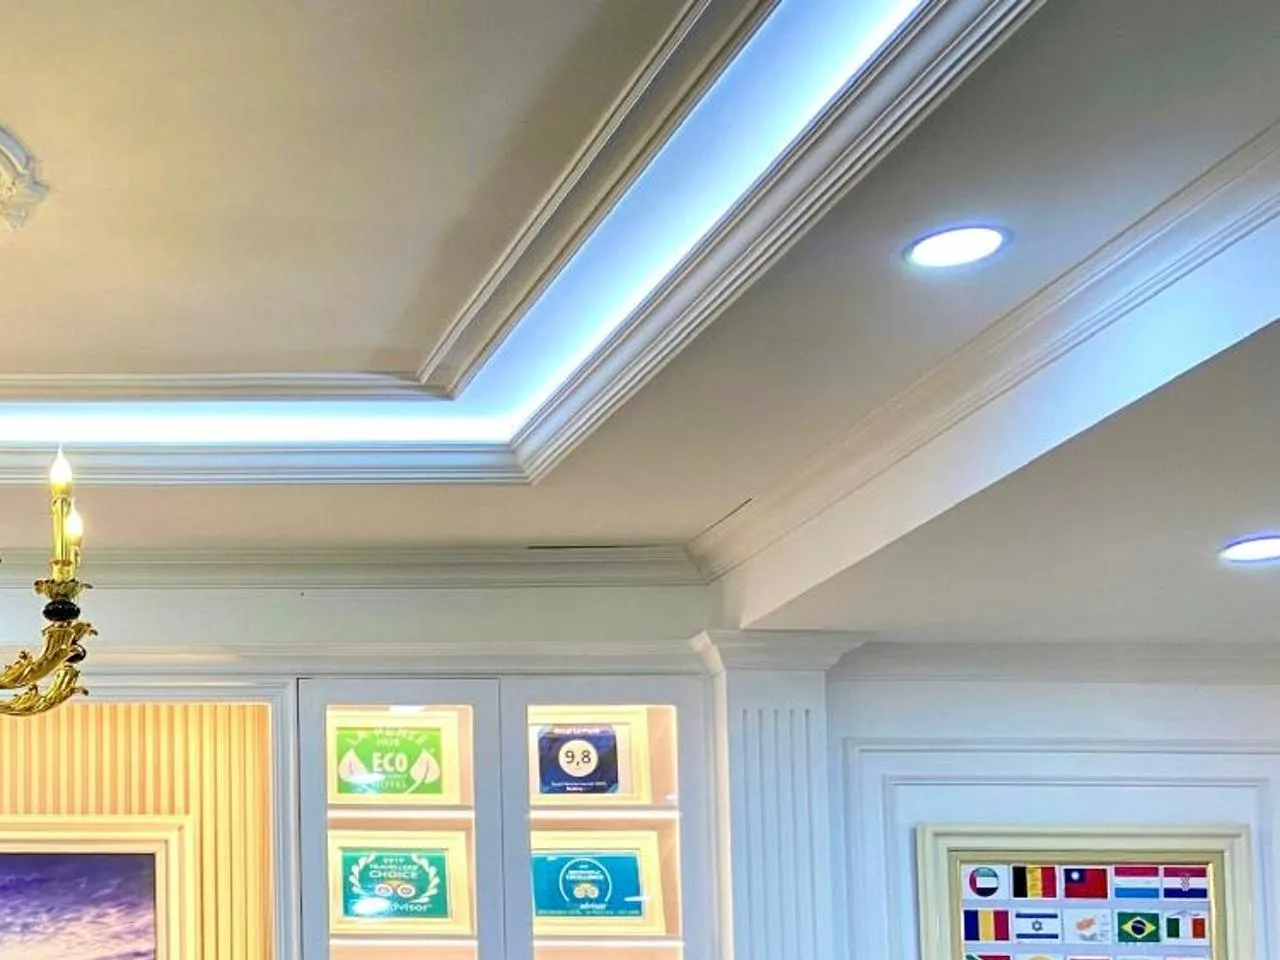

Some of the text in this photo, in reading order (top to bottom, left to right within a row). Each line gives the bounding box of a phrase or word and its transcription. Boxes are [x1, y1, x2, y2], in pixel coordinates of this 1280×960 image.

[372, 751, 409, 773] ECO
[564, 749, 592, 766] 9,8
[369, 870, 418, 879] CHOICE
